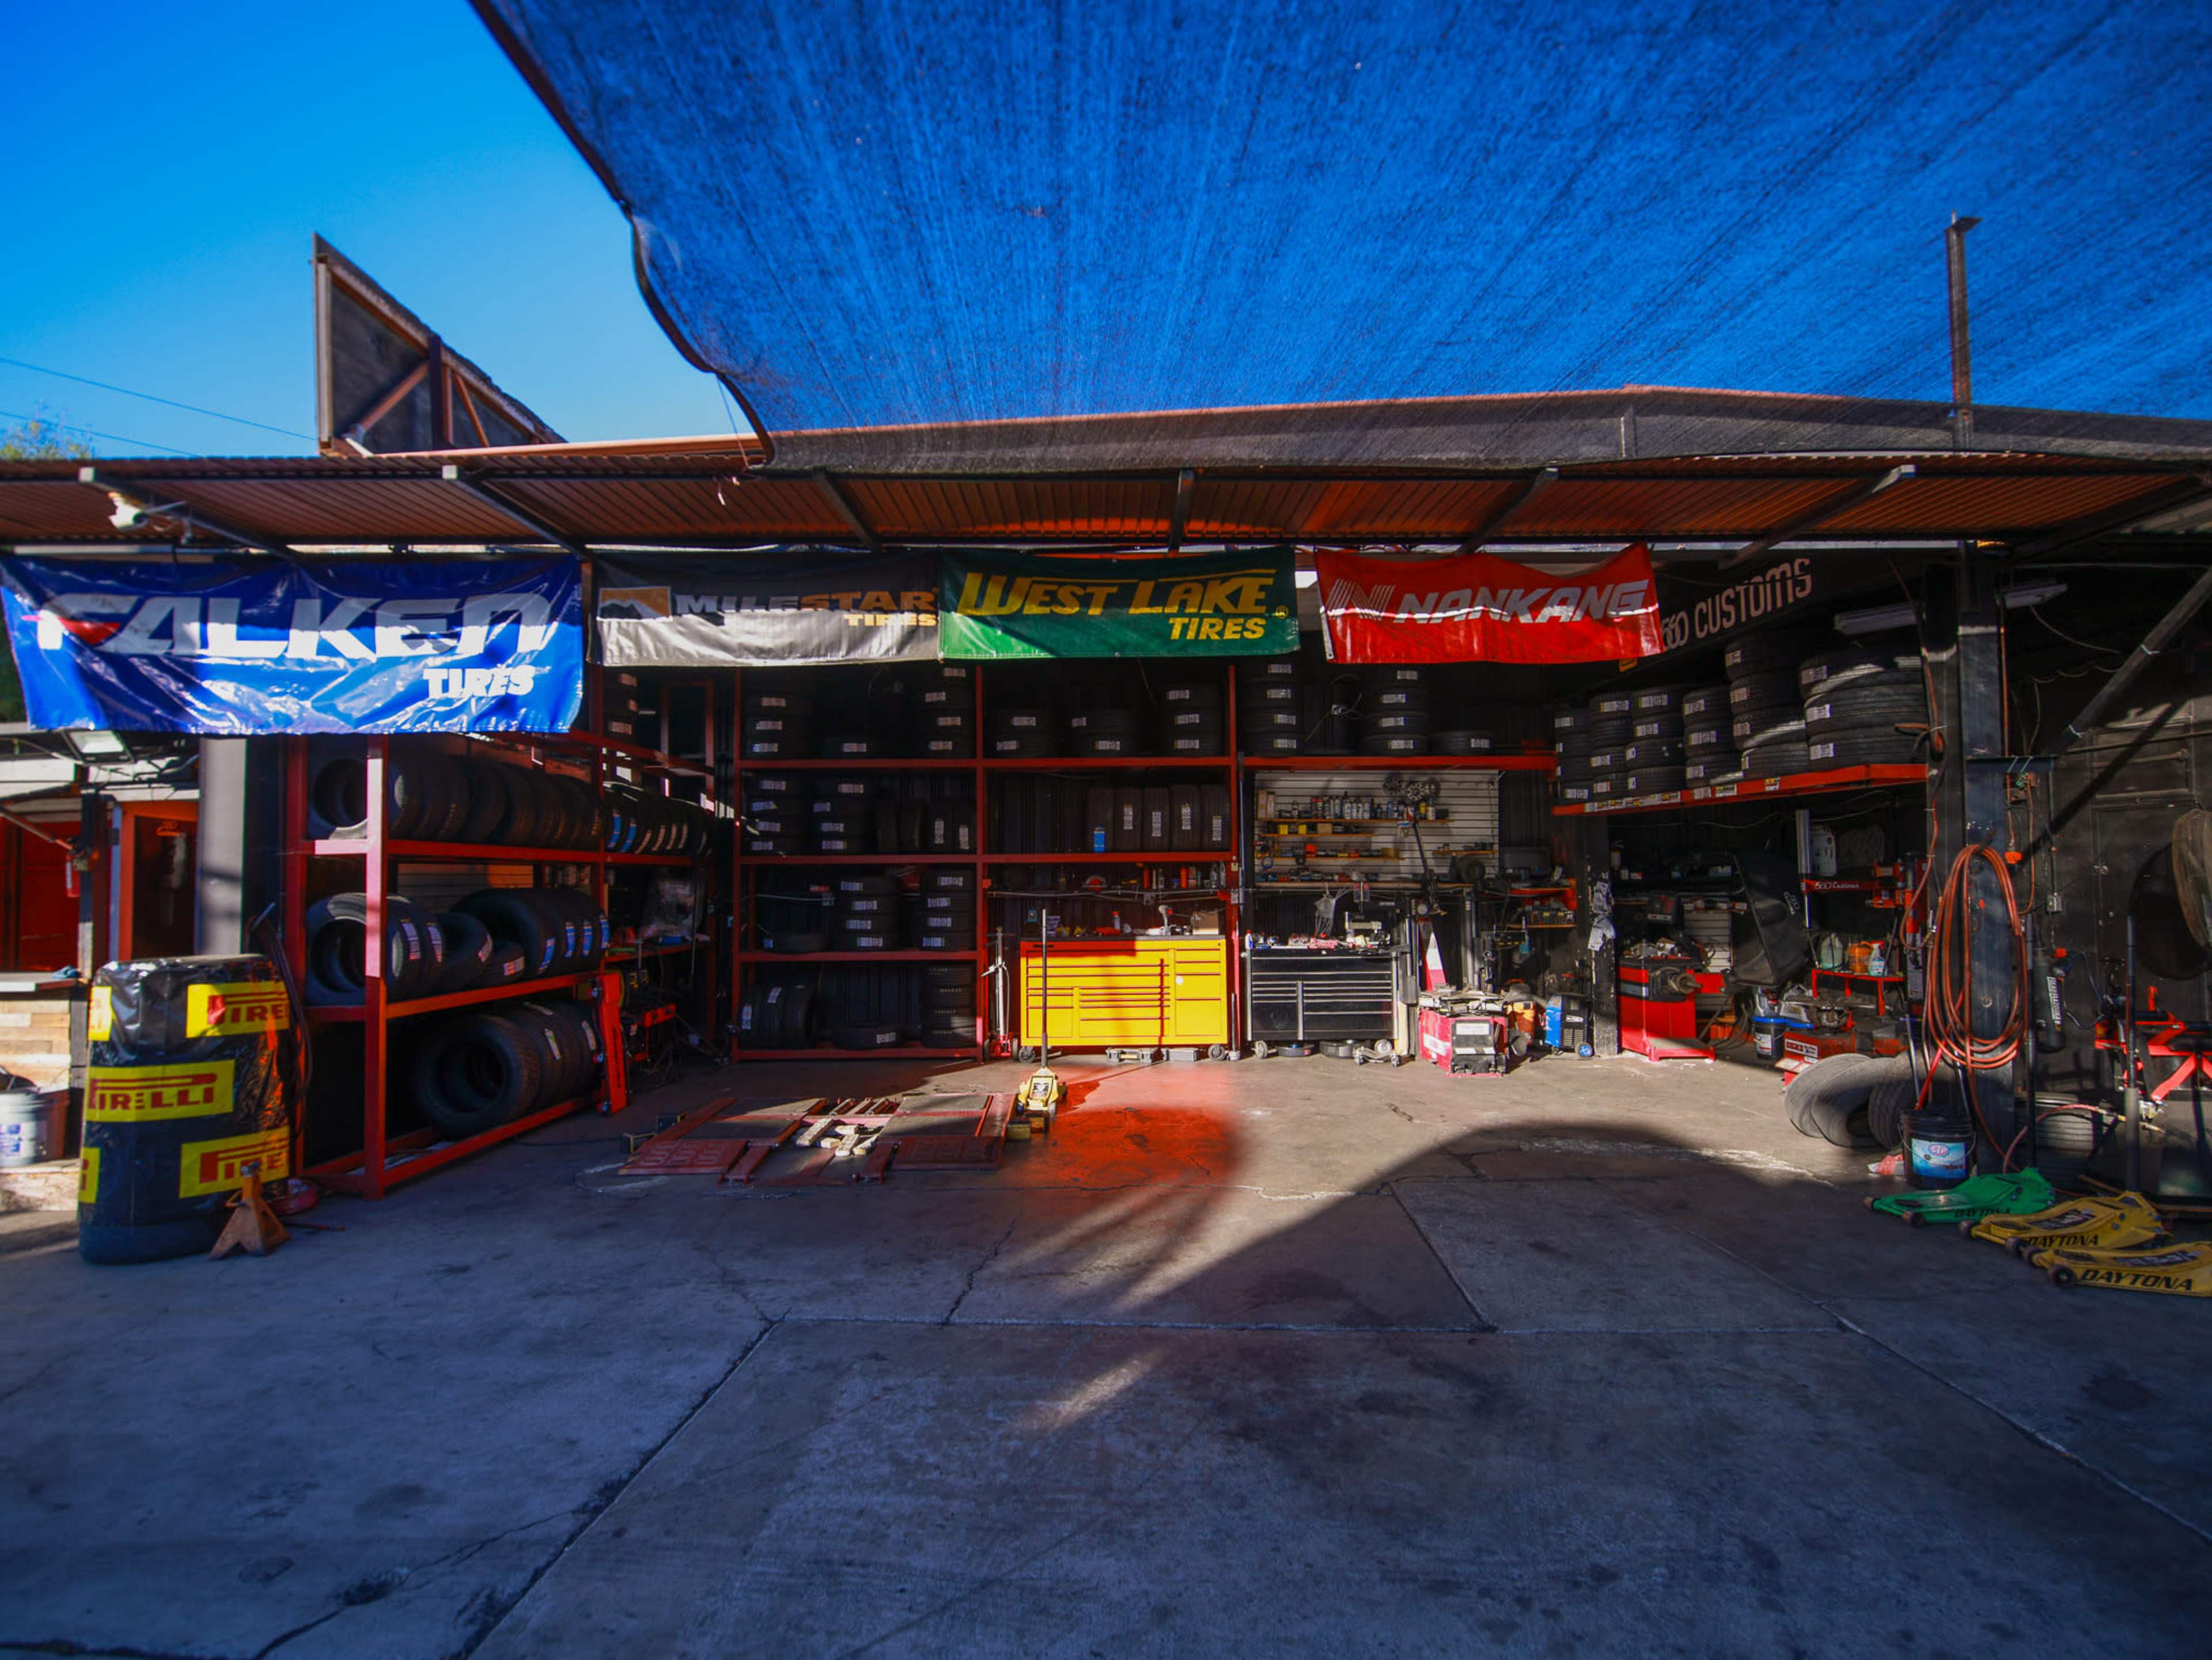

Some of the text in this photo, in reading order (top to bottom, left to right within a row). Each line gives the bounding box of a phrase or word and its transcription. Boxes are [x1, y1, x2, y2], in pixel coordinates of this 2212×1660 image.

[675, 591, 935, 614] MILESTAR
[957, 569, 1277, 616] WEST LAKE
[1393, 578, 1649, 624] NANKANG
[1695, 558, 1813, 639] CUSTOMS
[38, 592, 553, 662] FALKEN
[844, 613, 937, 626] TIRES
[1169, 617, 1266, 640] TIRES
[423, 664, 535, 699] TIRES
[88, 1073, 217, 1111] PIRELLI
[2080, 1269, 2193, 1291] DAYTONA
